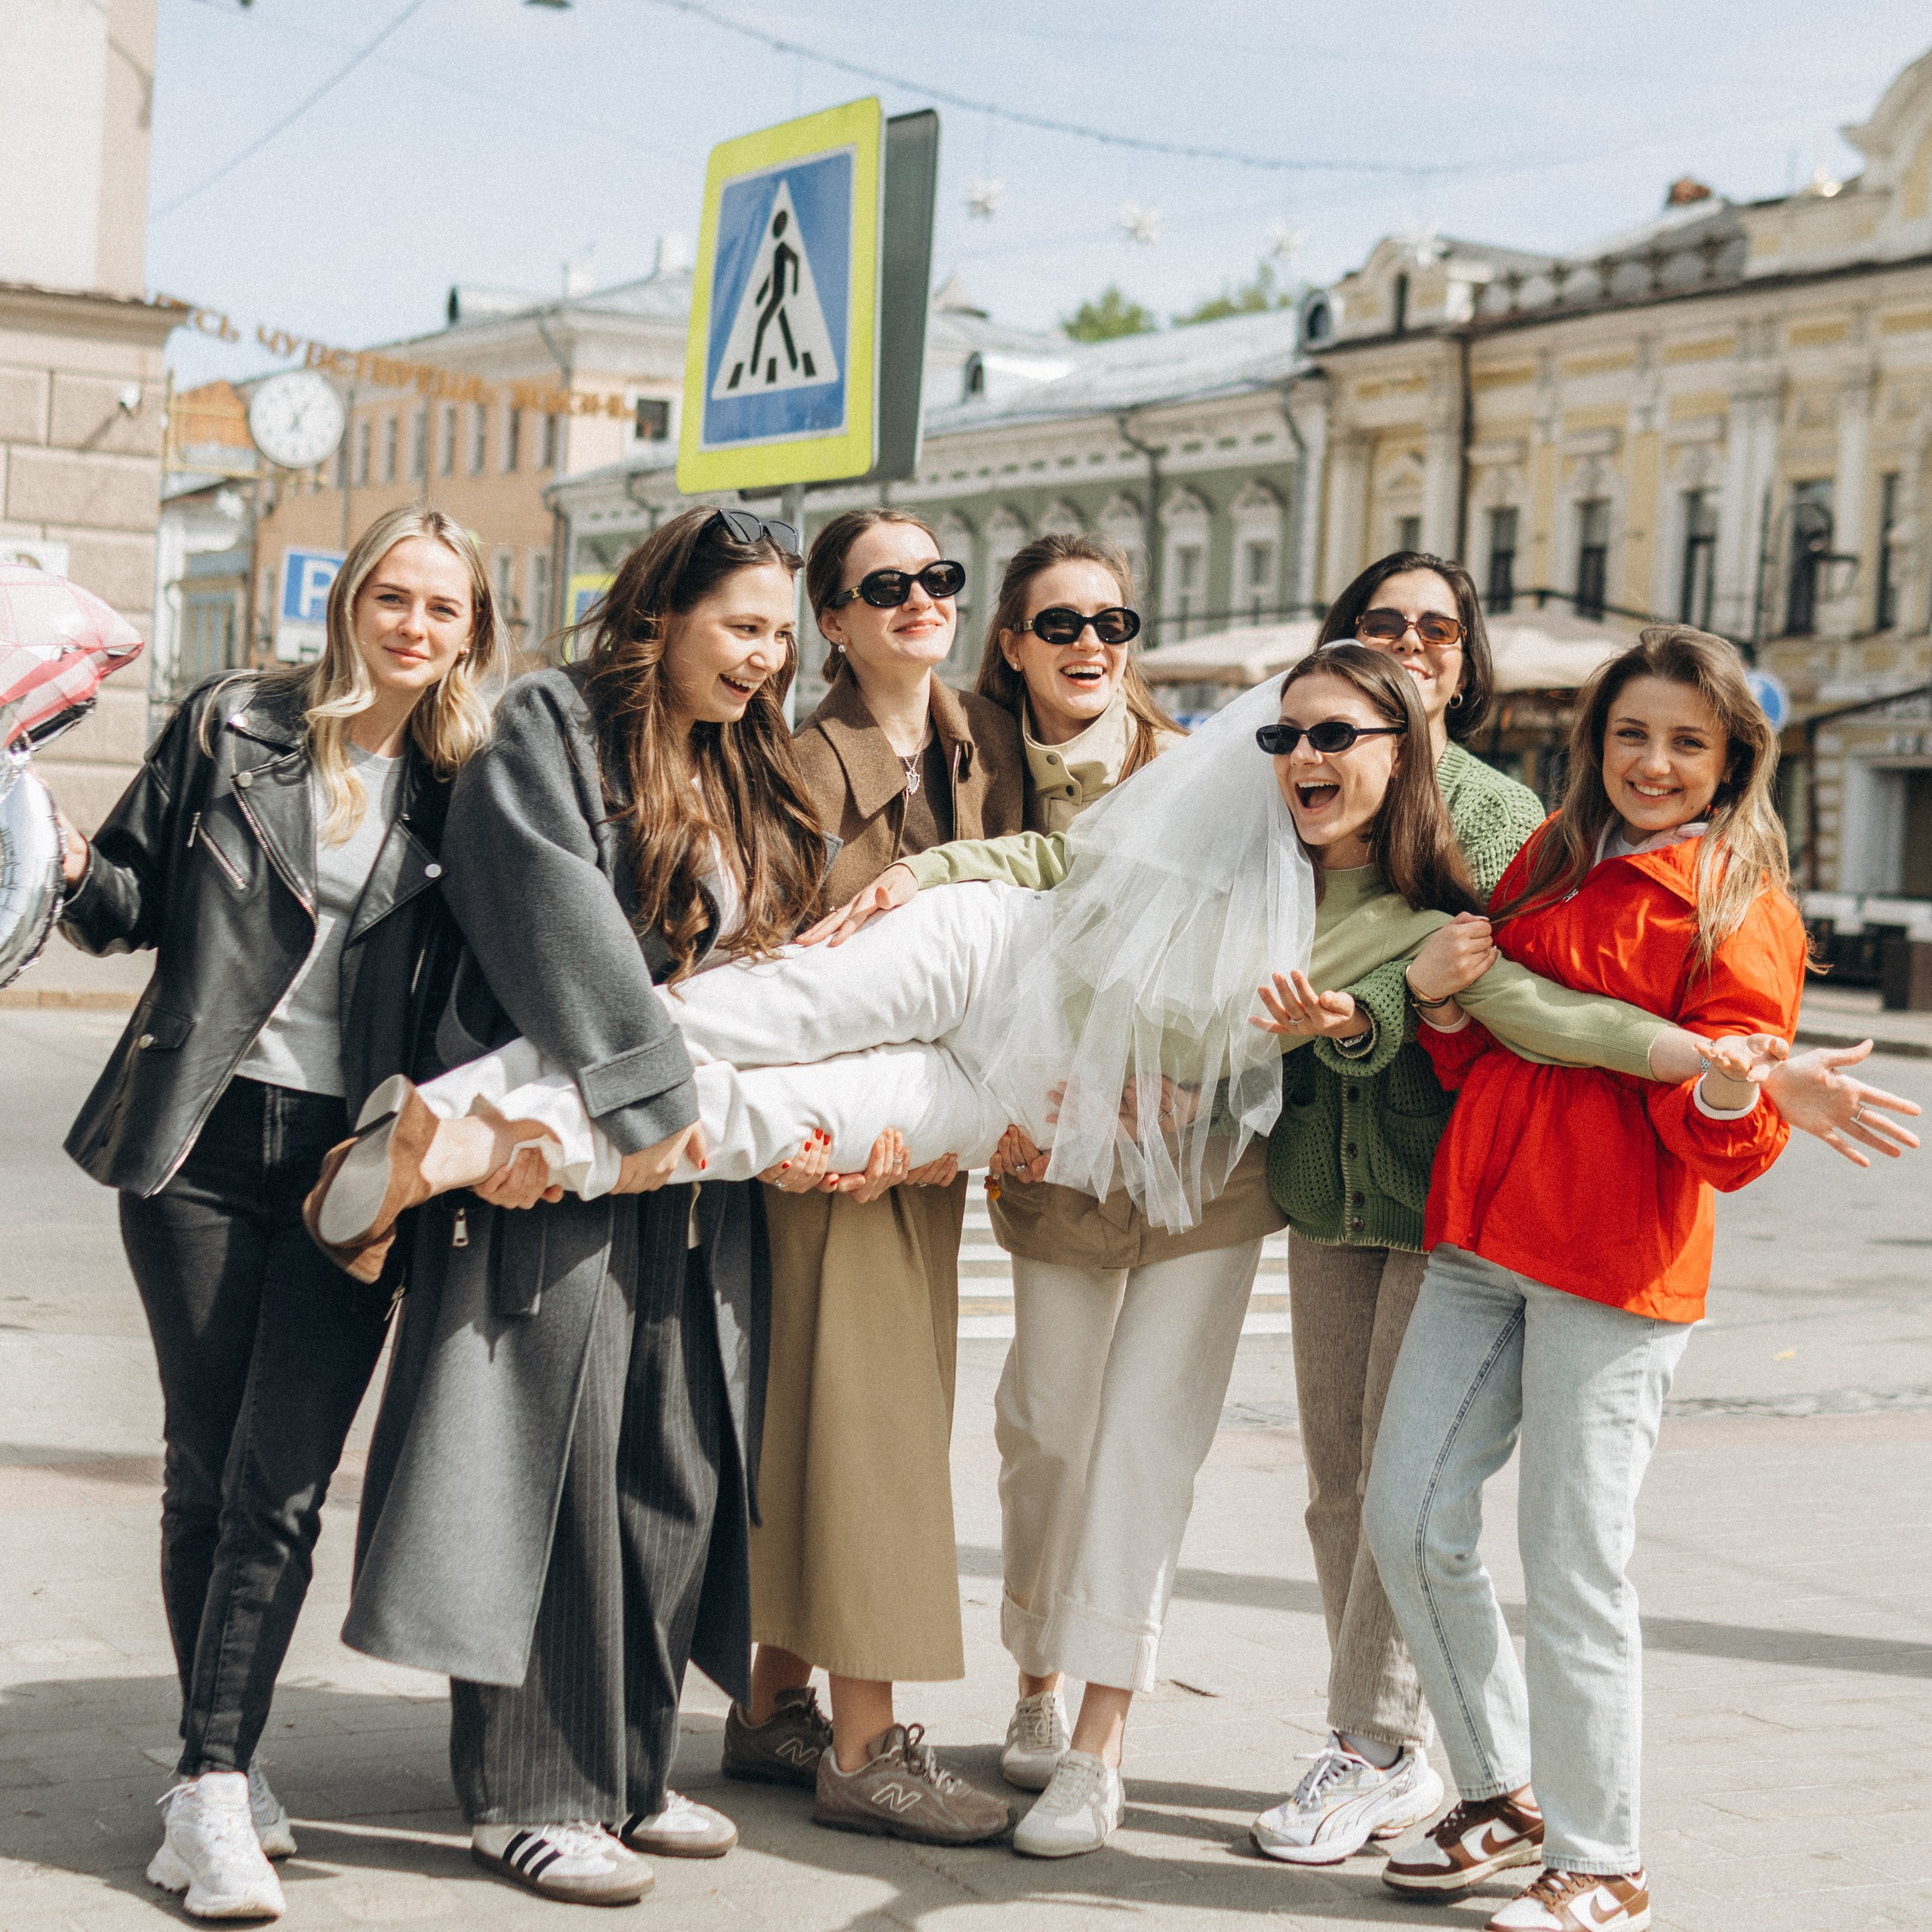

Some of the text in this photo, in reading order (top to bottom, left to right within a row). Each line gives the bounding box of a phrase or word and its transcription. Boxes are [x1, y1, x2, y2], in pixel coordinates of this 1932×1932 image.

[300, 558, 340, 617] P
[775, 1736, 820, 1767] N
[871, 1781, 923, 1814] N
